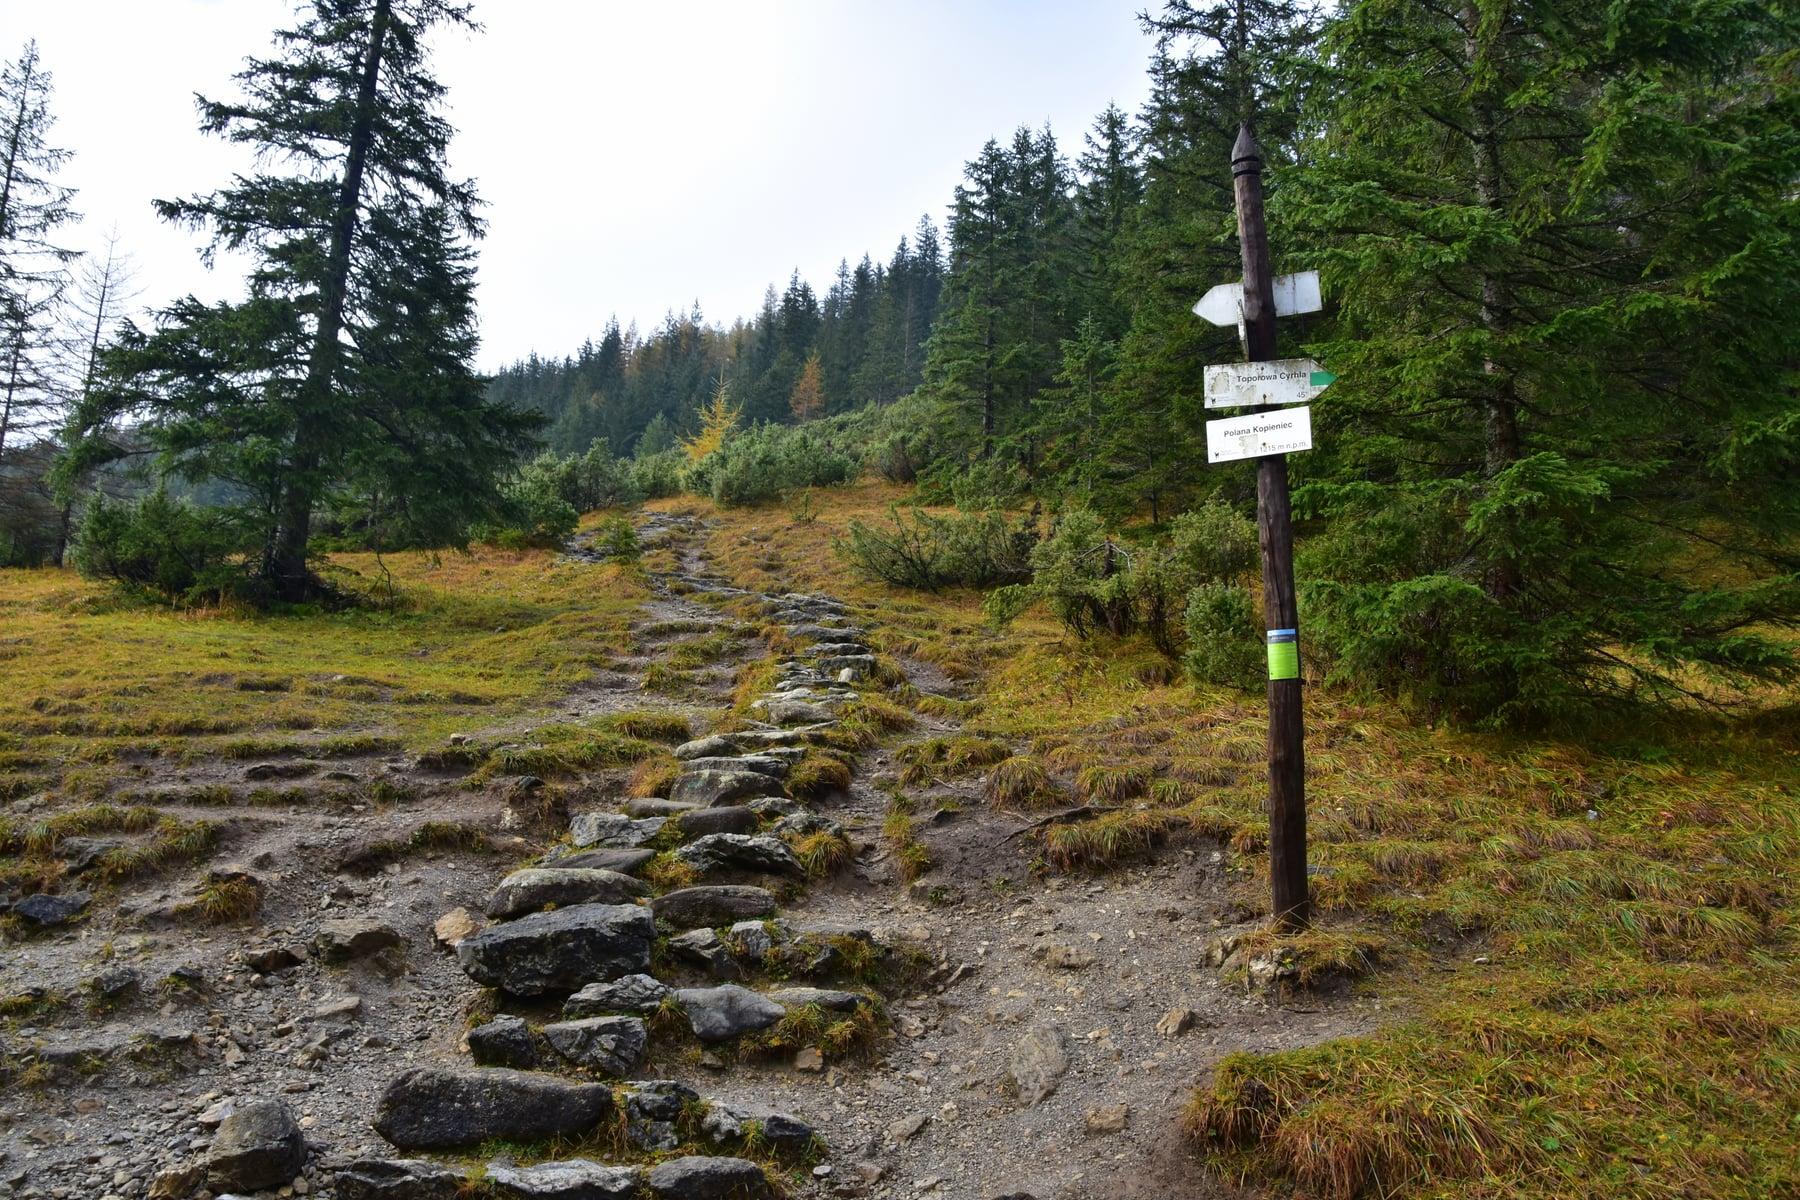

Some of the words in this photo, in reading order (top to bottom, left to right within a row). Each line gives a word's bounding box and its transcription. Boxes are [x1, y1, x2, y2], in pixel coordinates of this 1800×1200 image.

[1237, 374, 1277, 383] Toporowa
[1279, 371, 1306, 381] Cyrhla
[1223, 428, 1251, 437] Polana
[1253, 422, 1292, 434] Kopieniec
